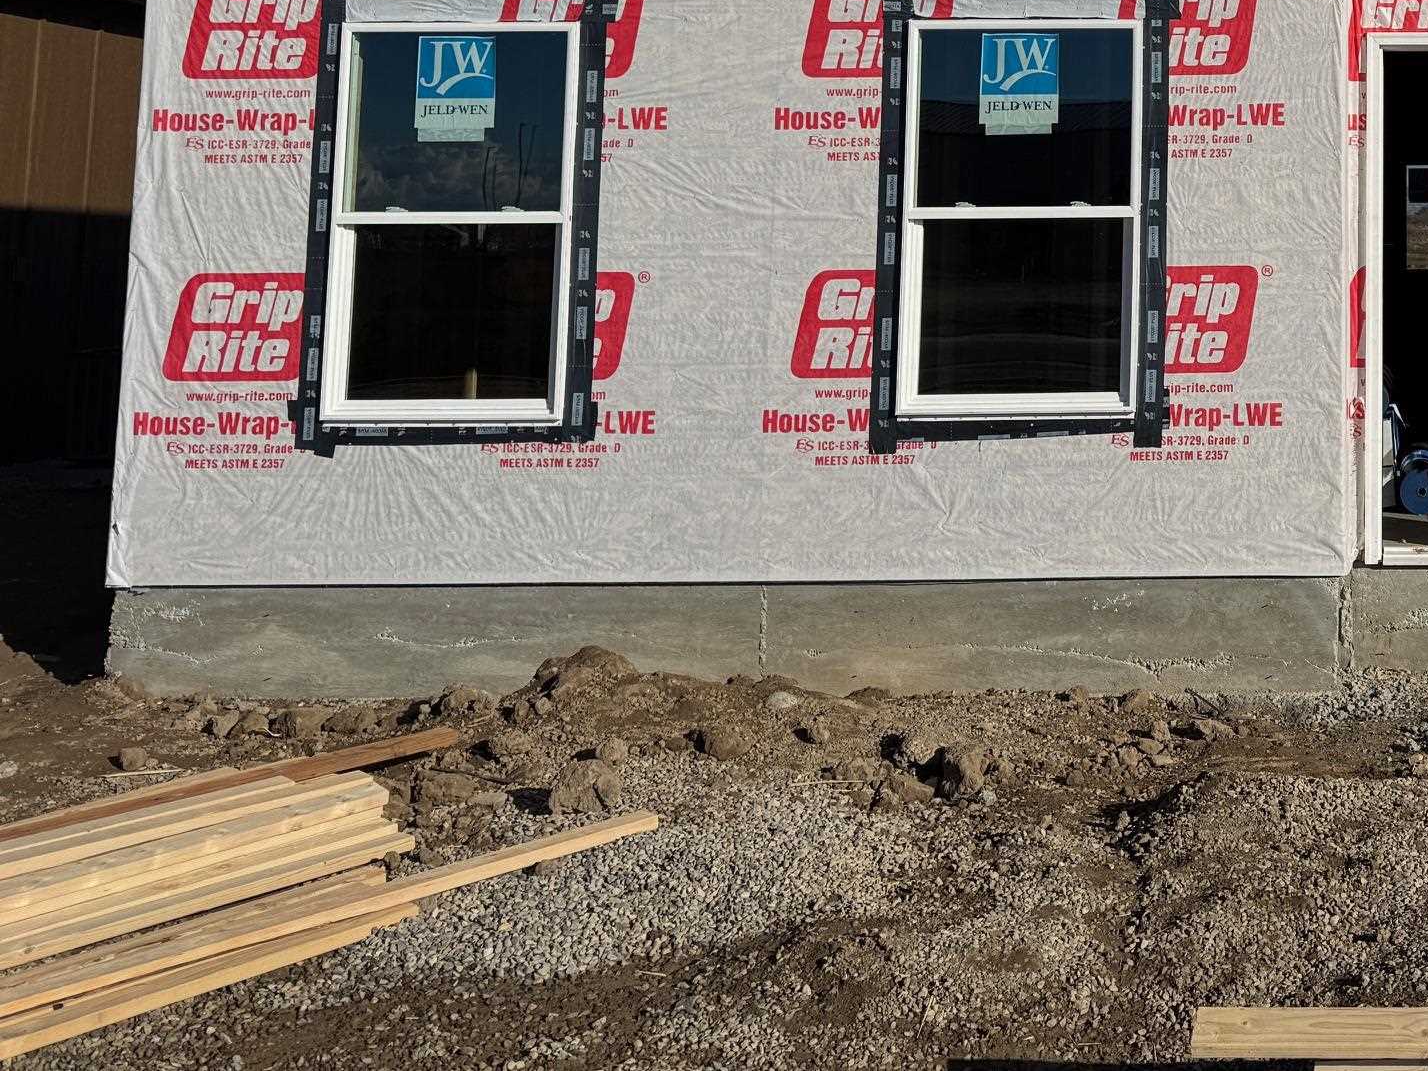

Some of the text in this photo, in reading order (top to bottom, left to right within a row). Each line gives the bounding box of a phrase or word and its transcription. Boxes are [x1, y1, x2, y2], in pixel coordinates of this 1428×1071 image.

[201, 30, 307, 70] Rite
[1169, 27, 1230, 68] ite
[420, 41, 493, 87] JW
[983, 39, 1056, 84] JW
[205, 88, 311, 100] www.grip-rite.com
[1169, 104, 1284, 129] Wrap-LWE
[282, 139, 311, 149] Grade
[1212, 135, 1240, 144] Grade
[204, 154, 237, 164] MEETS
[240, 154, 267, 164] ASTM
[280, 154, 303, 164] 2357
[827, 152, 860, 161] MEETS
[1171, 149, 1198, 159] ASTM
[1210, 148, 1233, 158] 2357
[1167, 274, 1240, 324] rip
[191, 281, 304, 331] Grip
[1165, 323, 1228, 364] ite
[182, 330, 290, 373] Rite
[186, 391, 293, 403] www.grip-rite.com
[1169, 402, 1282, 430] Wrap-LWE
[1207, 436, 1236, 445] Grade
[264, 444, 293, 454] Grade
[578, 443, 607, 453] Grade
[815, 455, 848, 465] MEETS
[852, 455, 879, 465] ASTM
[892, 454, 915, 464] 2357
[1130, 451, 1162, 461] MEETS
[1166, 451, 1193, 460] ASTM
[1206, 450, 1228, 460] 2357
[185, 459, 218, 469] MEETS
[221, 459, 249, 469] ASTM
[261, 459, 284, 469] 2357
[500, 458, 532, 468] MEETS
[536, 458, 563, 468] ASTM
[575, 458, 599, 468] 2357
